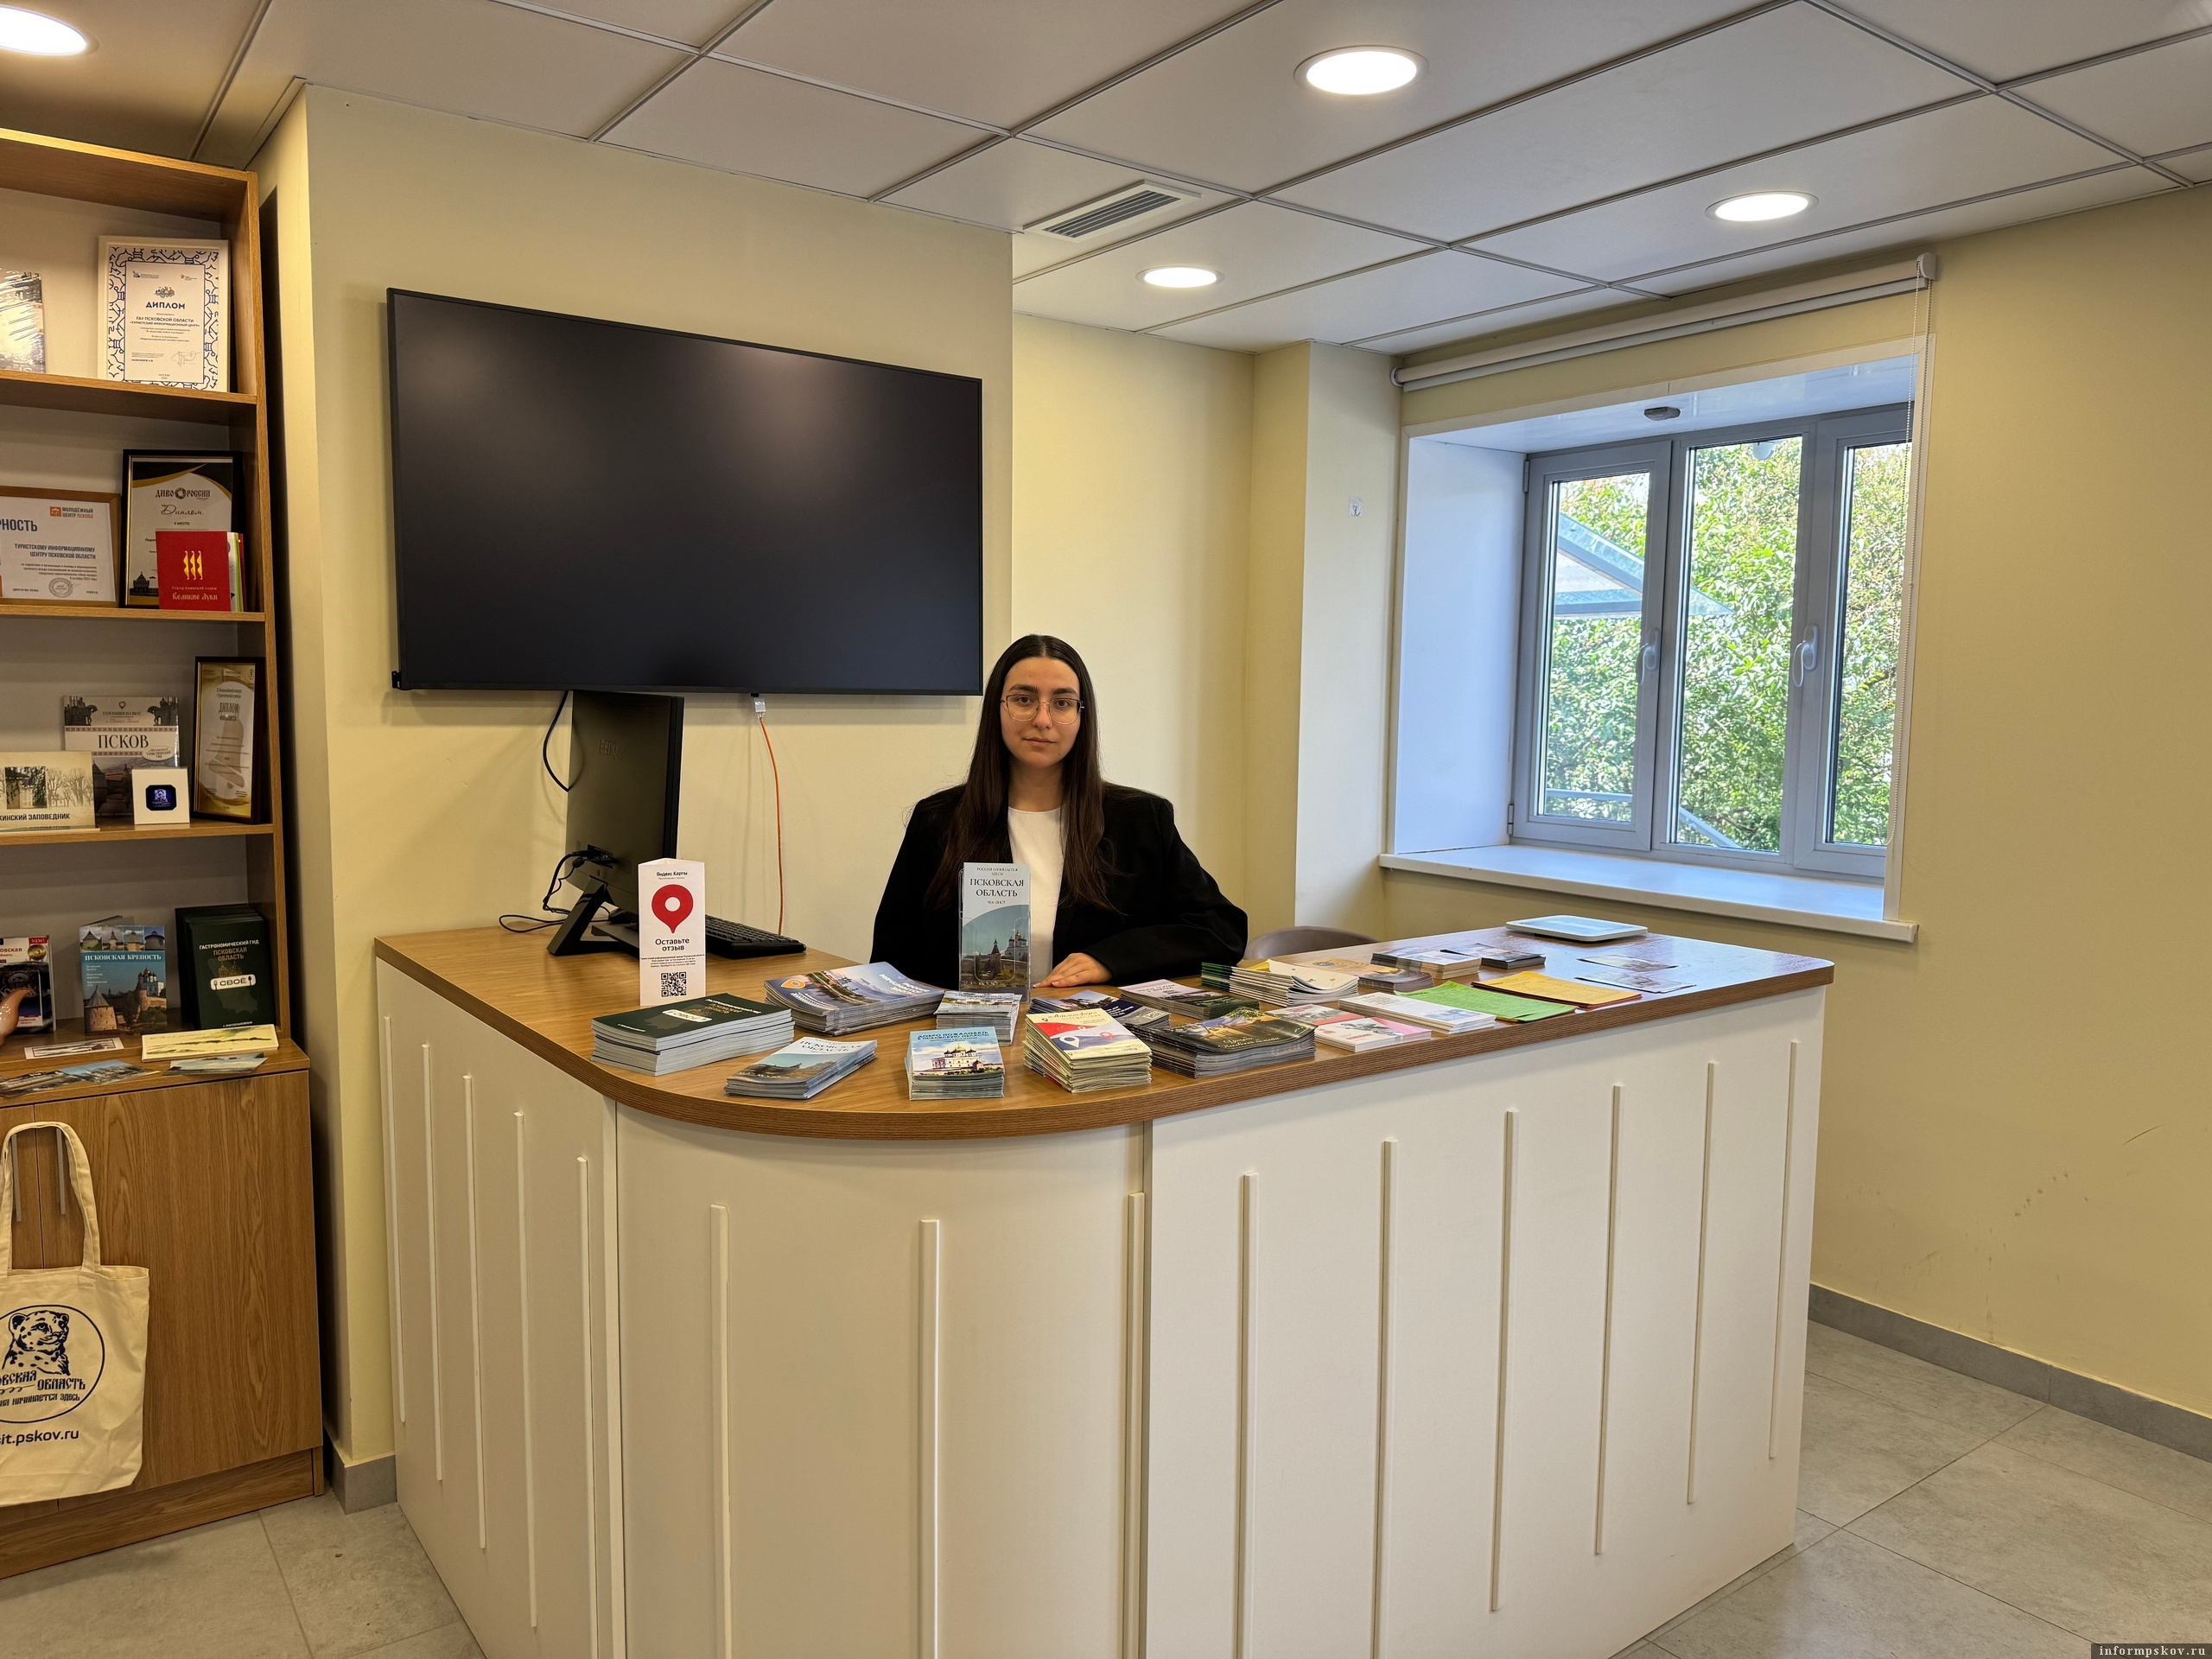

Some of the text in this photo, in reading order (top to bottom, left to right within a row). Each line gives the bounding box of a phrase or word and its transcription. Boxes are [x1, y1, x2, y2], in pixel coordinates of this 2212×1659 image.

[156, 489, 211, 499] ДИВО РОССИИ
[98, 734, 149, 749] ПСКОВ
[969, 878, 1024, 887] ПСКОВСКАЯ
[976, 888, 1018, 897] ОБЛАСТЬ
[199, 940, 249, 950] ГАСТРОНОМИЧЕСКИЙ
[213, 947, 248, 956] ПСКОВСКАЯ
[219, 977, 247, 987] СВОЁ
[37, 1377, 86, 1390] ОБЛАСТЬ
[12, 1393, 58, 1406] НАЧИНАЕТСЯ
[60, 1393, 80, 1402] ЗДЕСЬ
